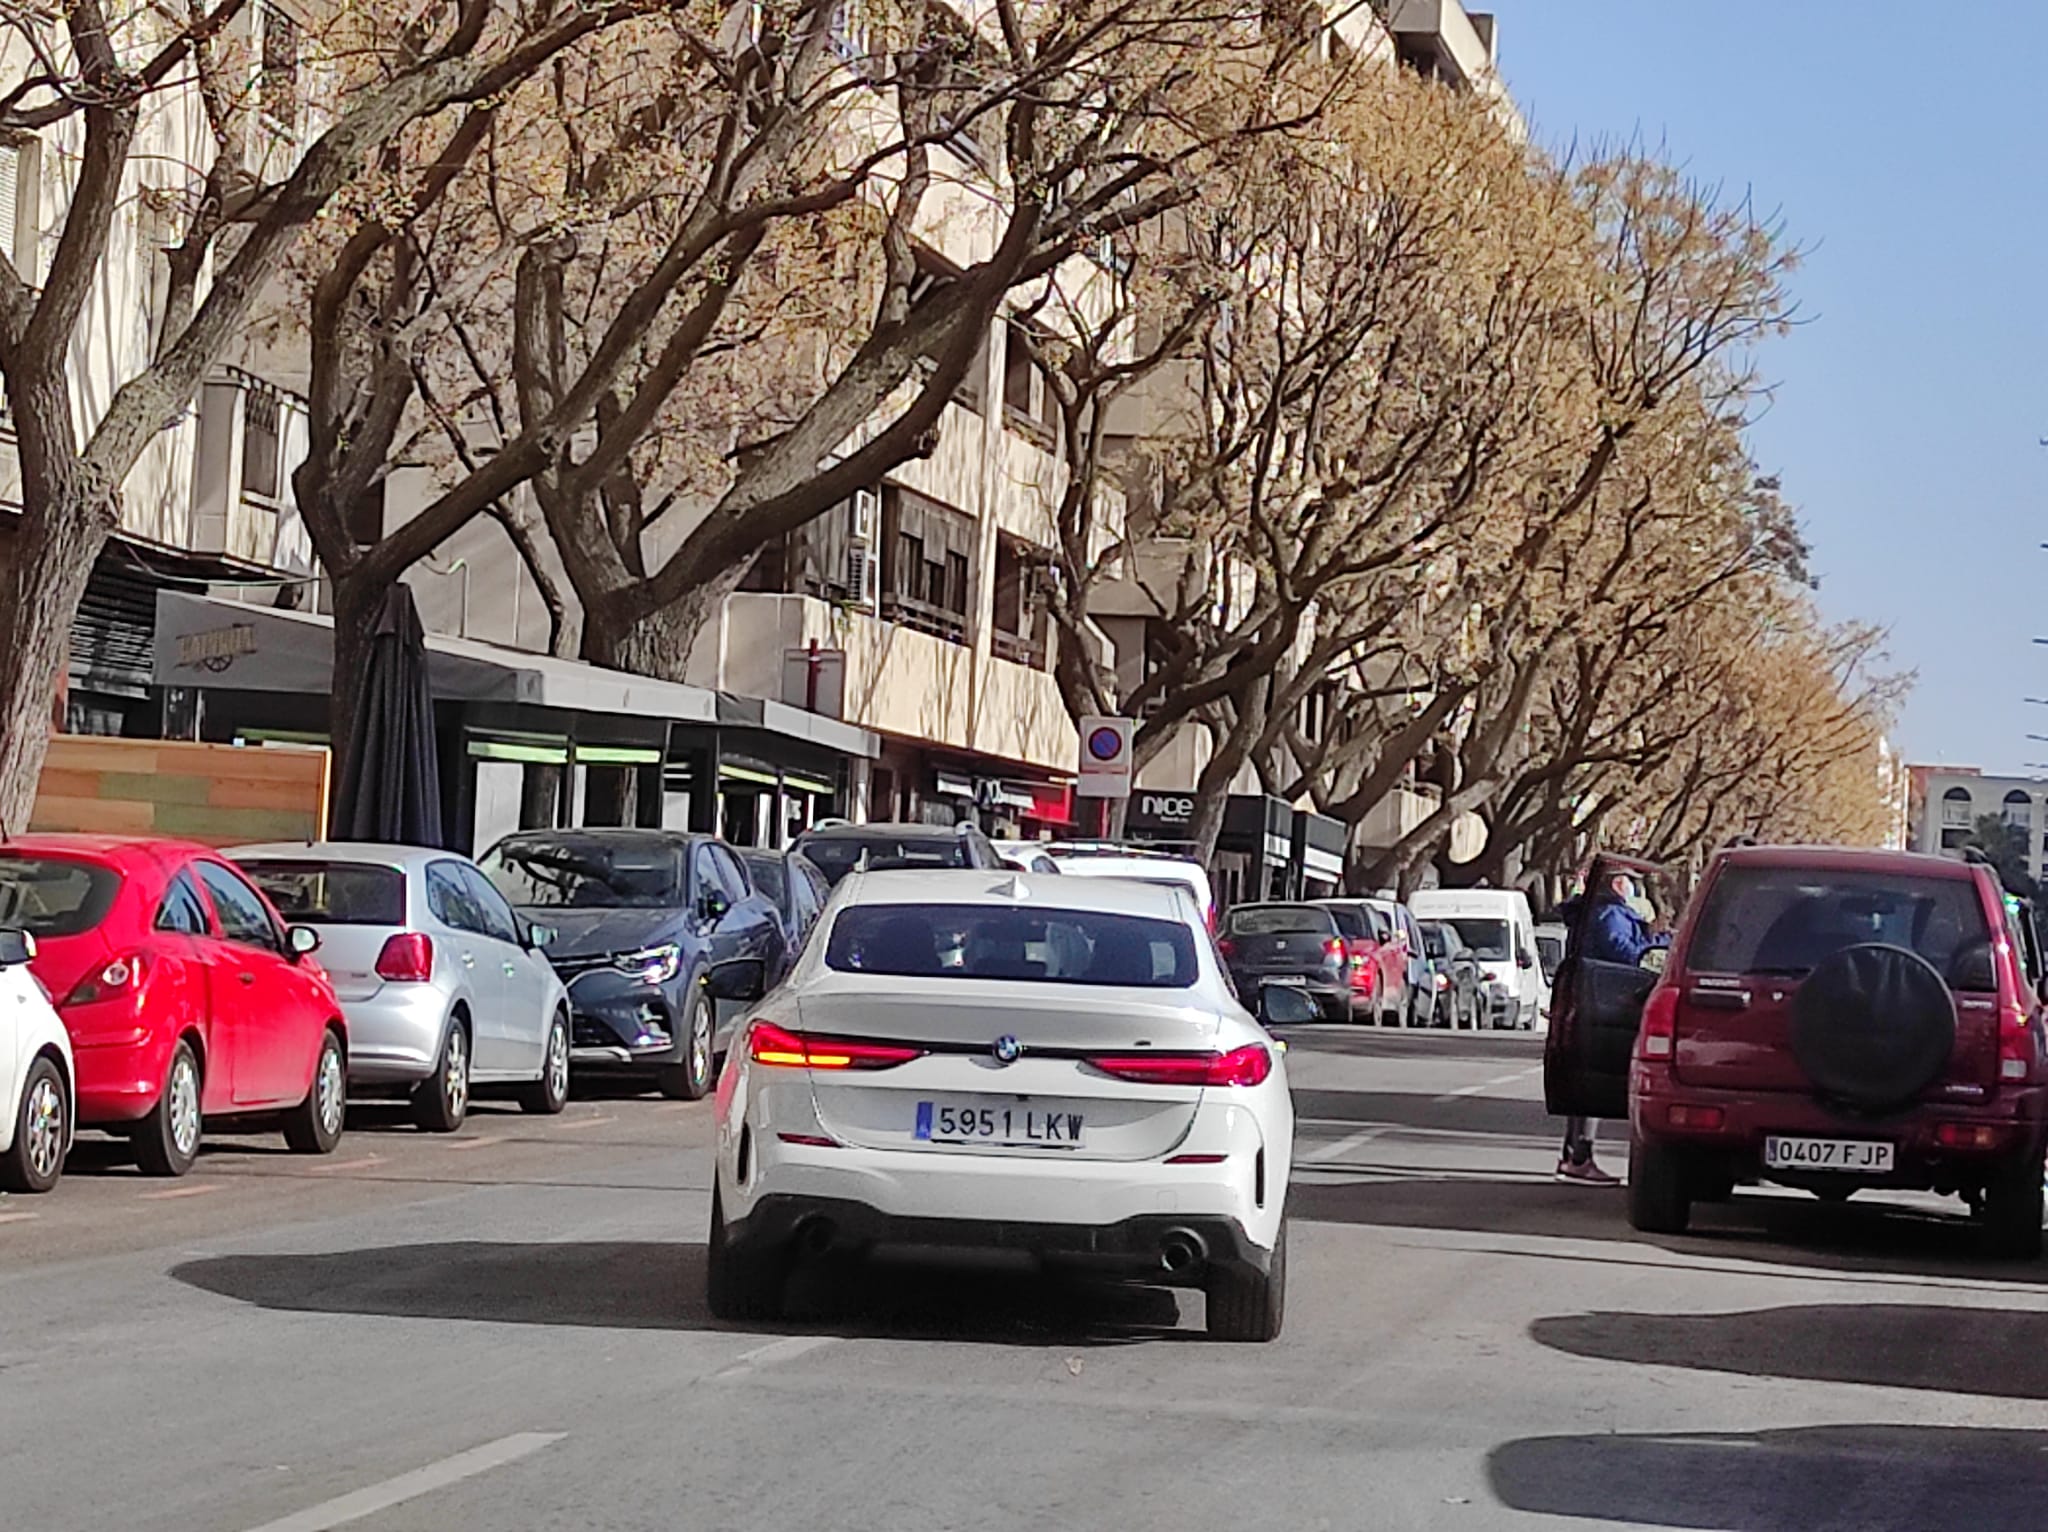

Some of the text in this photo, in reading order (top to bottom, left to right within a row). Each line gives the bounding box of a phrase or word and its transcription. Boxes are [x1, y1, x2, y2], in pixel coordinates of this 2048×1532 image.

[940, 1107, 1083, 1141] 5951 LKW
[1779, 1141, 1889, 1166] 0407 FJP
